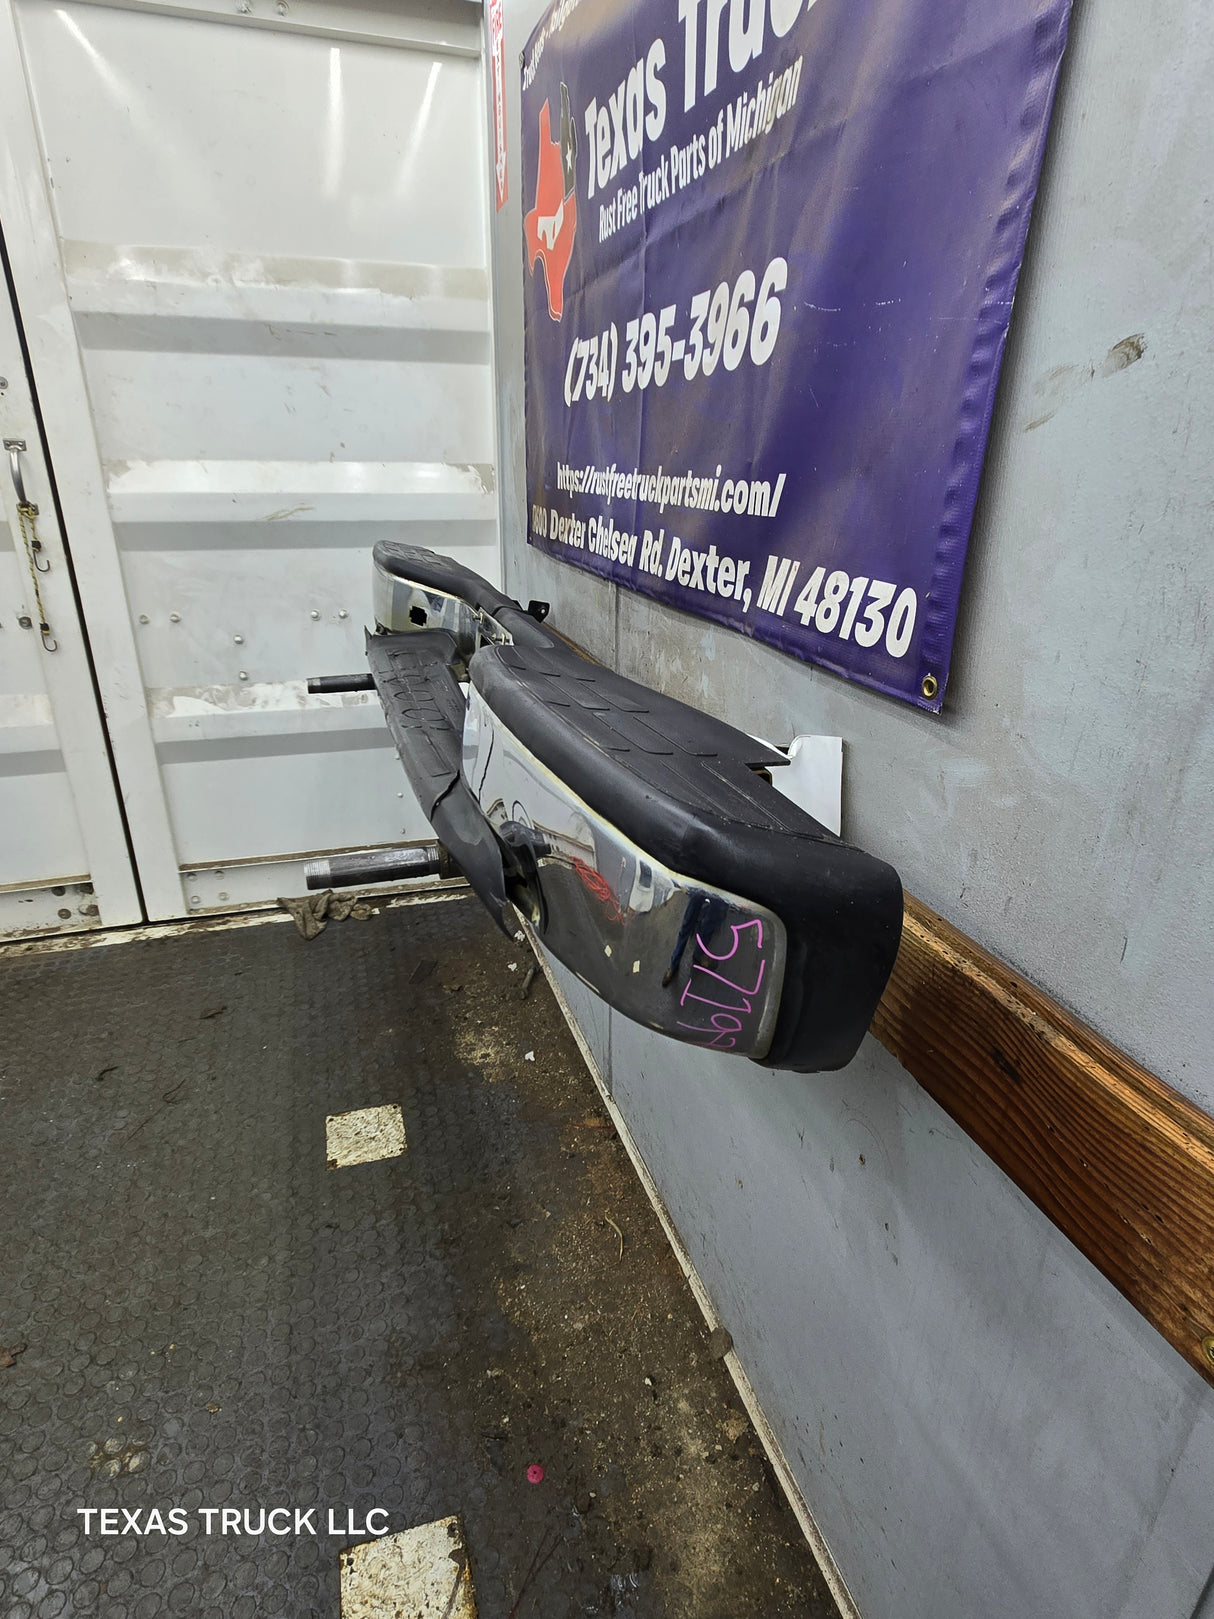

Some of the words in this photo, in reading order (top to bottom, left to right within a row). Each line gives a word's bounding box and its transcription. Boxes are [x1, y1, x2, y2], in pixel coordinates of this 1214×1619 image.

[585, 38, 667, 199] Texas
[678, 0, 817, 113] Tru
[599, 197, 617, 243] Rust
[617, 185, 638, 231] Free
[639, 154, 670, 215] Truck
[670, 134, 706, 194] Parts
[708, 109, 724, 169] of
[726, 55, 803, 159] Michigan
[563, 322, 616, 407] (734)
[622, 257, 788, 393] 395-3966
[557, 461, 787, 517] https://rustfreetruckpartsmi.com/
[549, 508, 586, 549] Dexter
[588, 515, 638, 567] Chelsea
[638, 528, 664, 577] Rd.
[665, 536, 752, 613] Dexter,
[756, 555, 801, 617] MI
[793, 566, 918, 658] 48130
